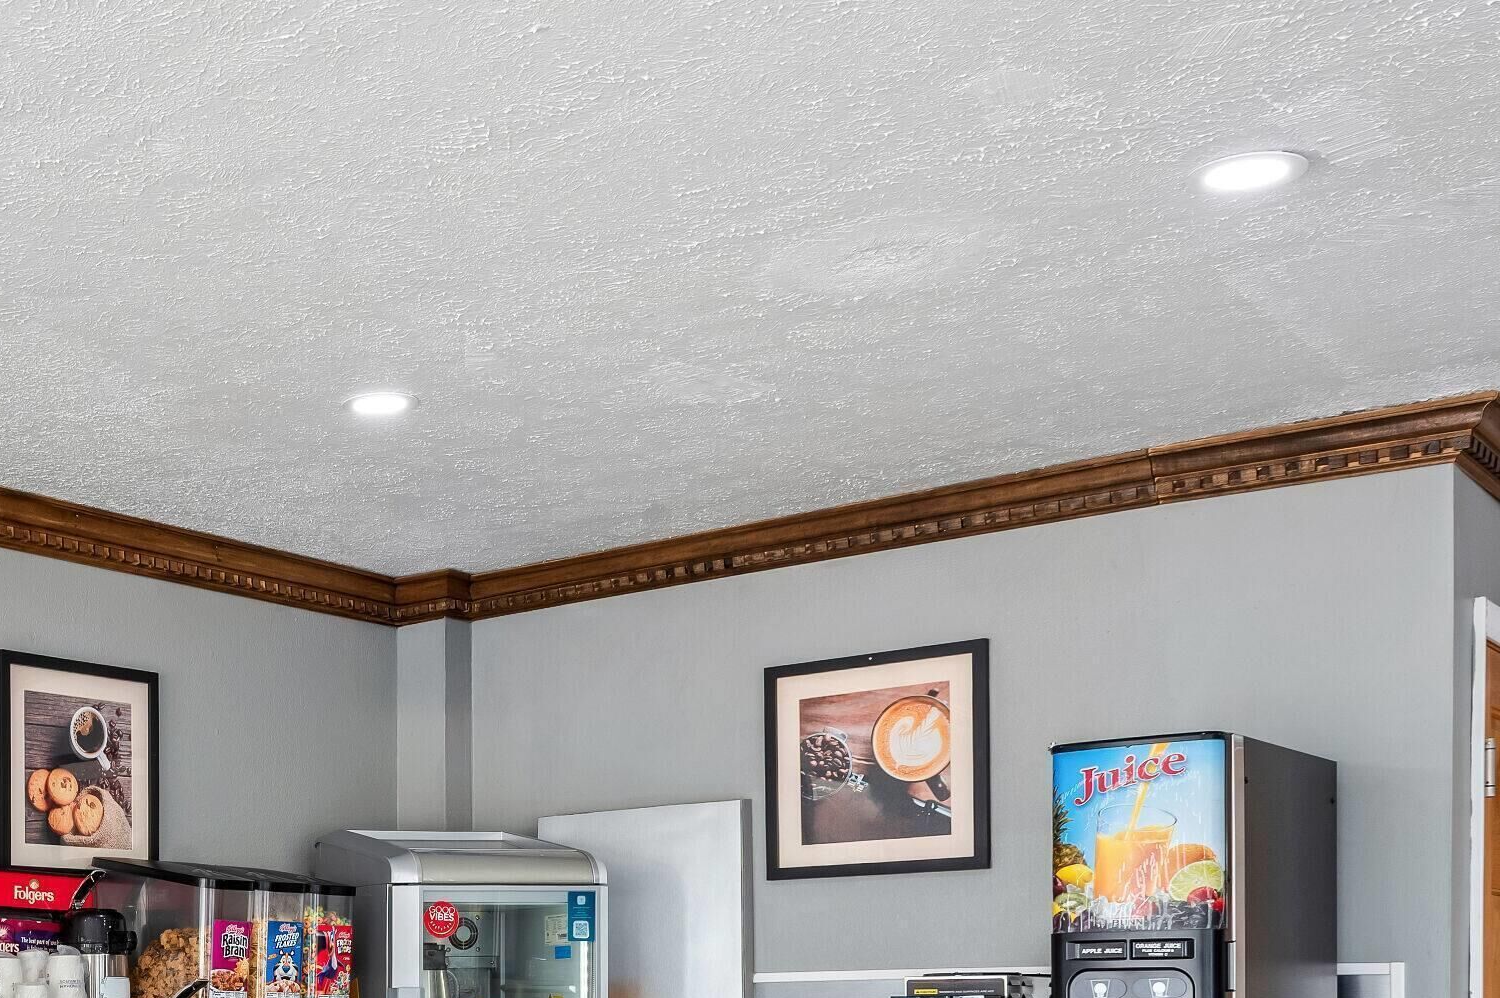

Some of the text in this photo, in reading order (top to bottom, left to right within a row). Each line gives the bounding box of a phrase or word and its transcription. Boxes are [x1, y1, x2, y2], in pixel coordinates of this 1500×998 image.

[1074, 752, 1187, 806] Juice
[13, 885, 55, 904] Folgers
[428, 905, 456, 914] GOOD
[429, 912, 455, 922] VIBES
[21, 936, 29, 944] The
[222, 933, 248, 949] Raisin
[275, 931, 300, 943] FROSTED
[276, 939, 298, 949] FLAKES
[223, 944, 246, 958] Bran
